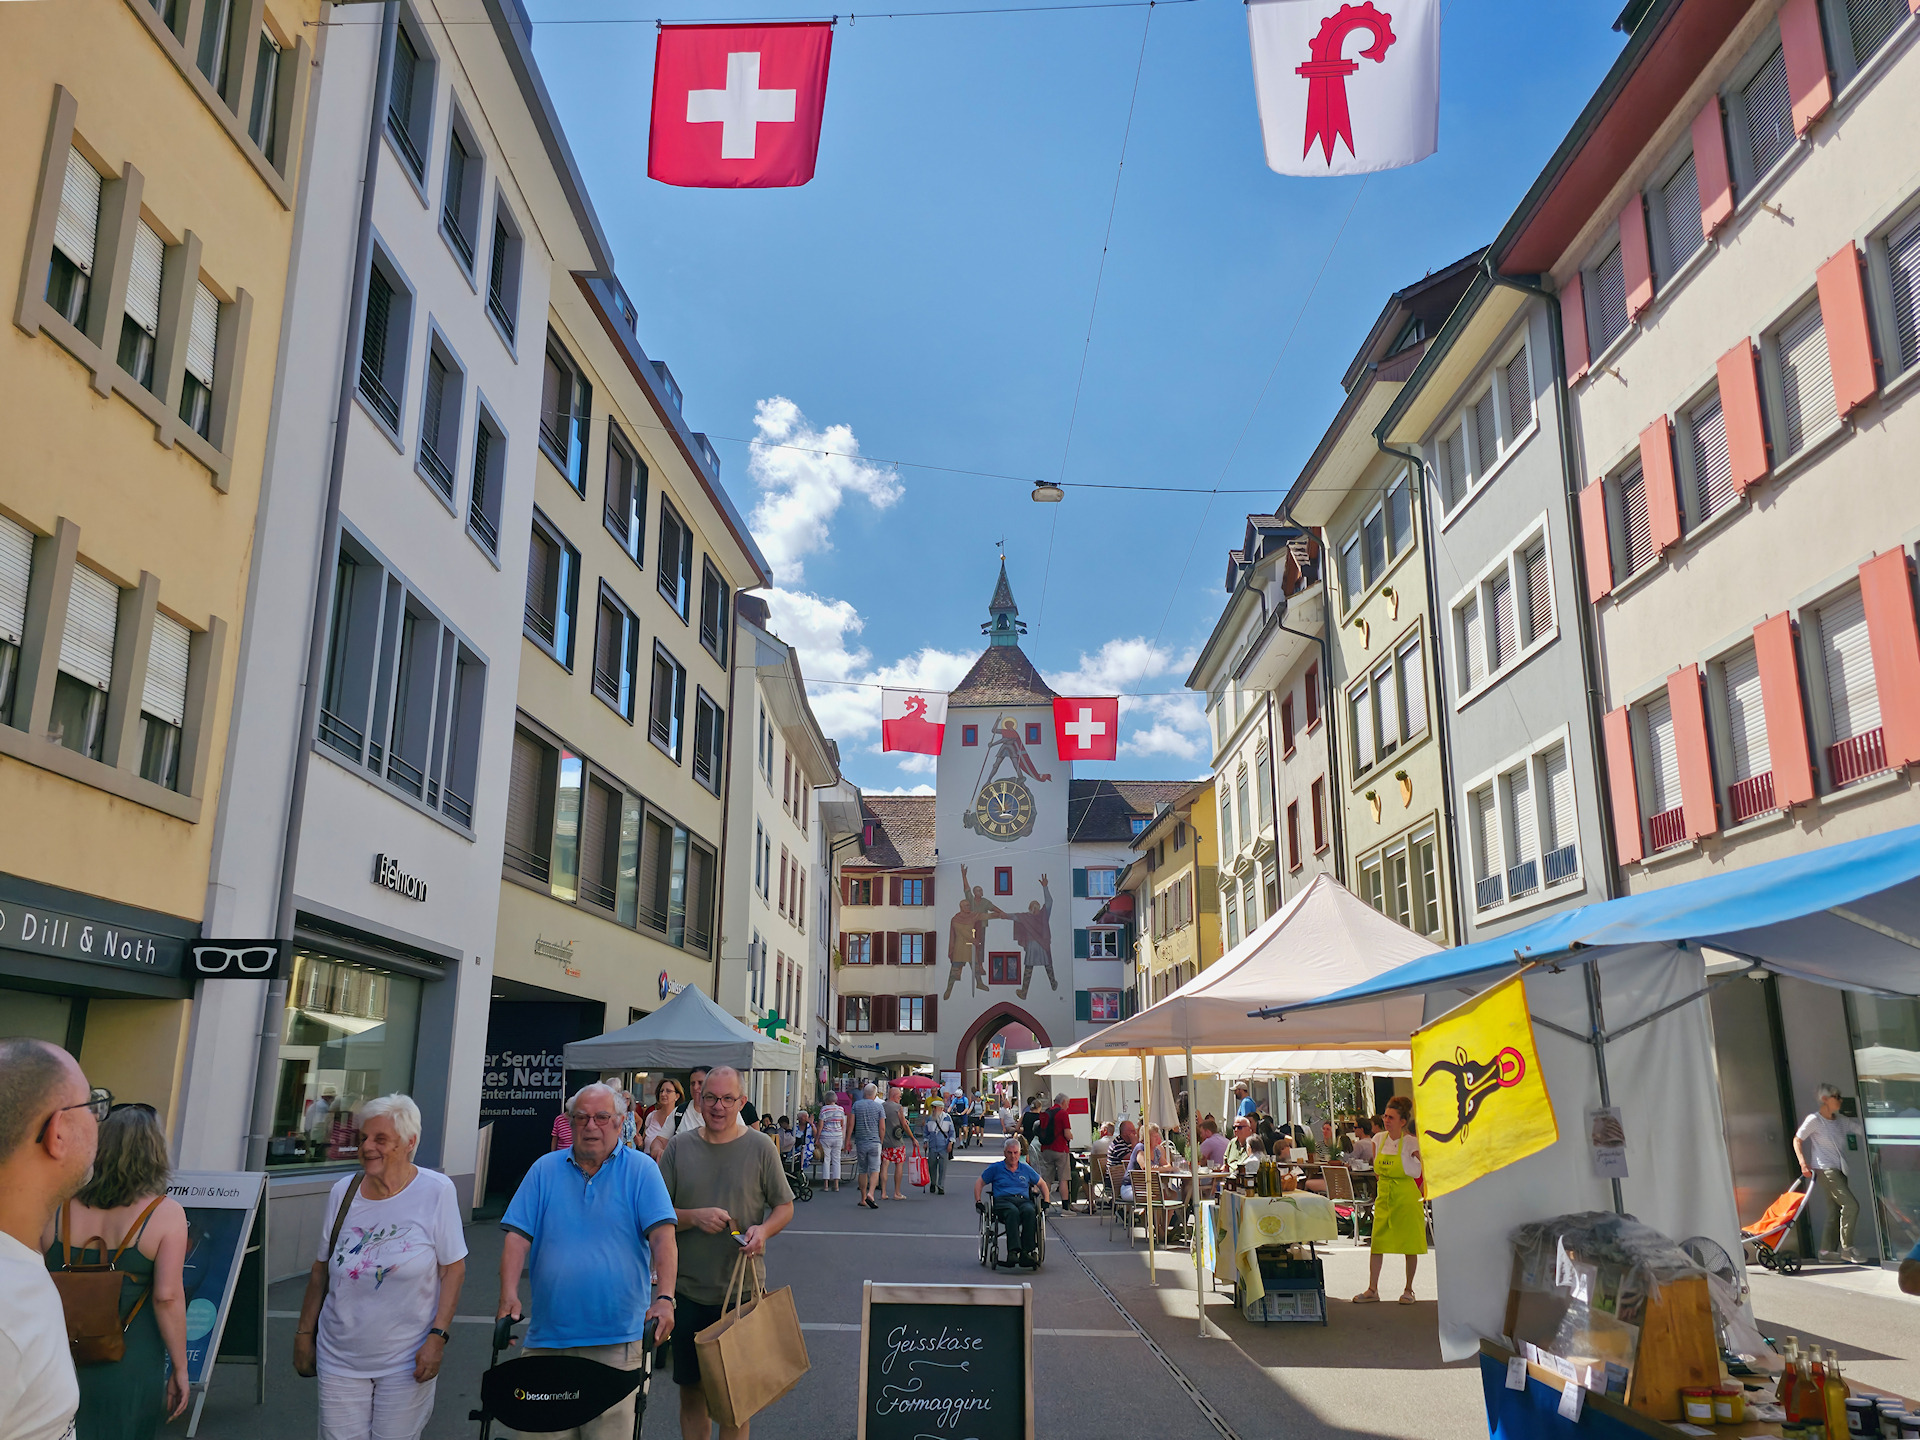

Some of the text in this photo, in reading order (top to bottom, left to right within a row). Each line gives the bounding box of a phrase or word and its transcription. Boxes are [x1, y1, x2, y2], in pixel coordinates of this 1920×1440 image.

[377, 853, 428, 902] fielmann
[21, 913, 156, 965] Dill & Noth
[502, 1050, 564, 1067] Service
[511, 1107, 538, 1116] bereit.
[190, 1186, 207, 1196] Dill
[207, 1187, 215, 1197] &
[216, 1187, 240, 1198] Noth
[881, 1324, 984, 1374] Geisskäse
[876, 1377, 995, 1428] Formaggini
